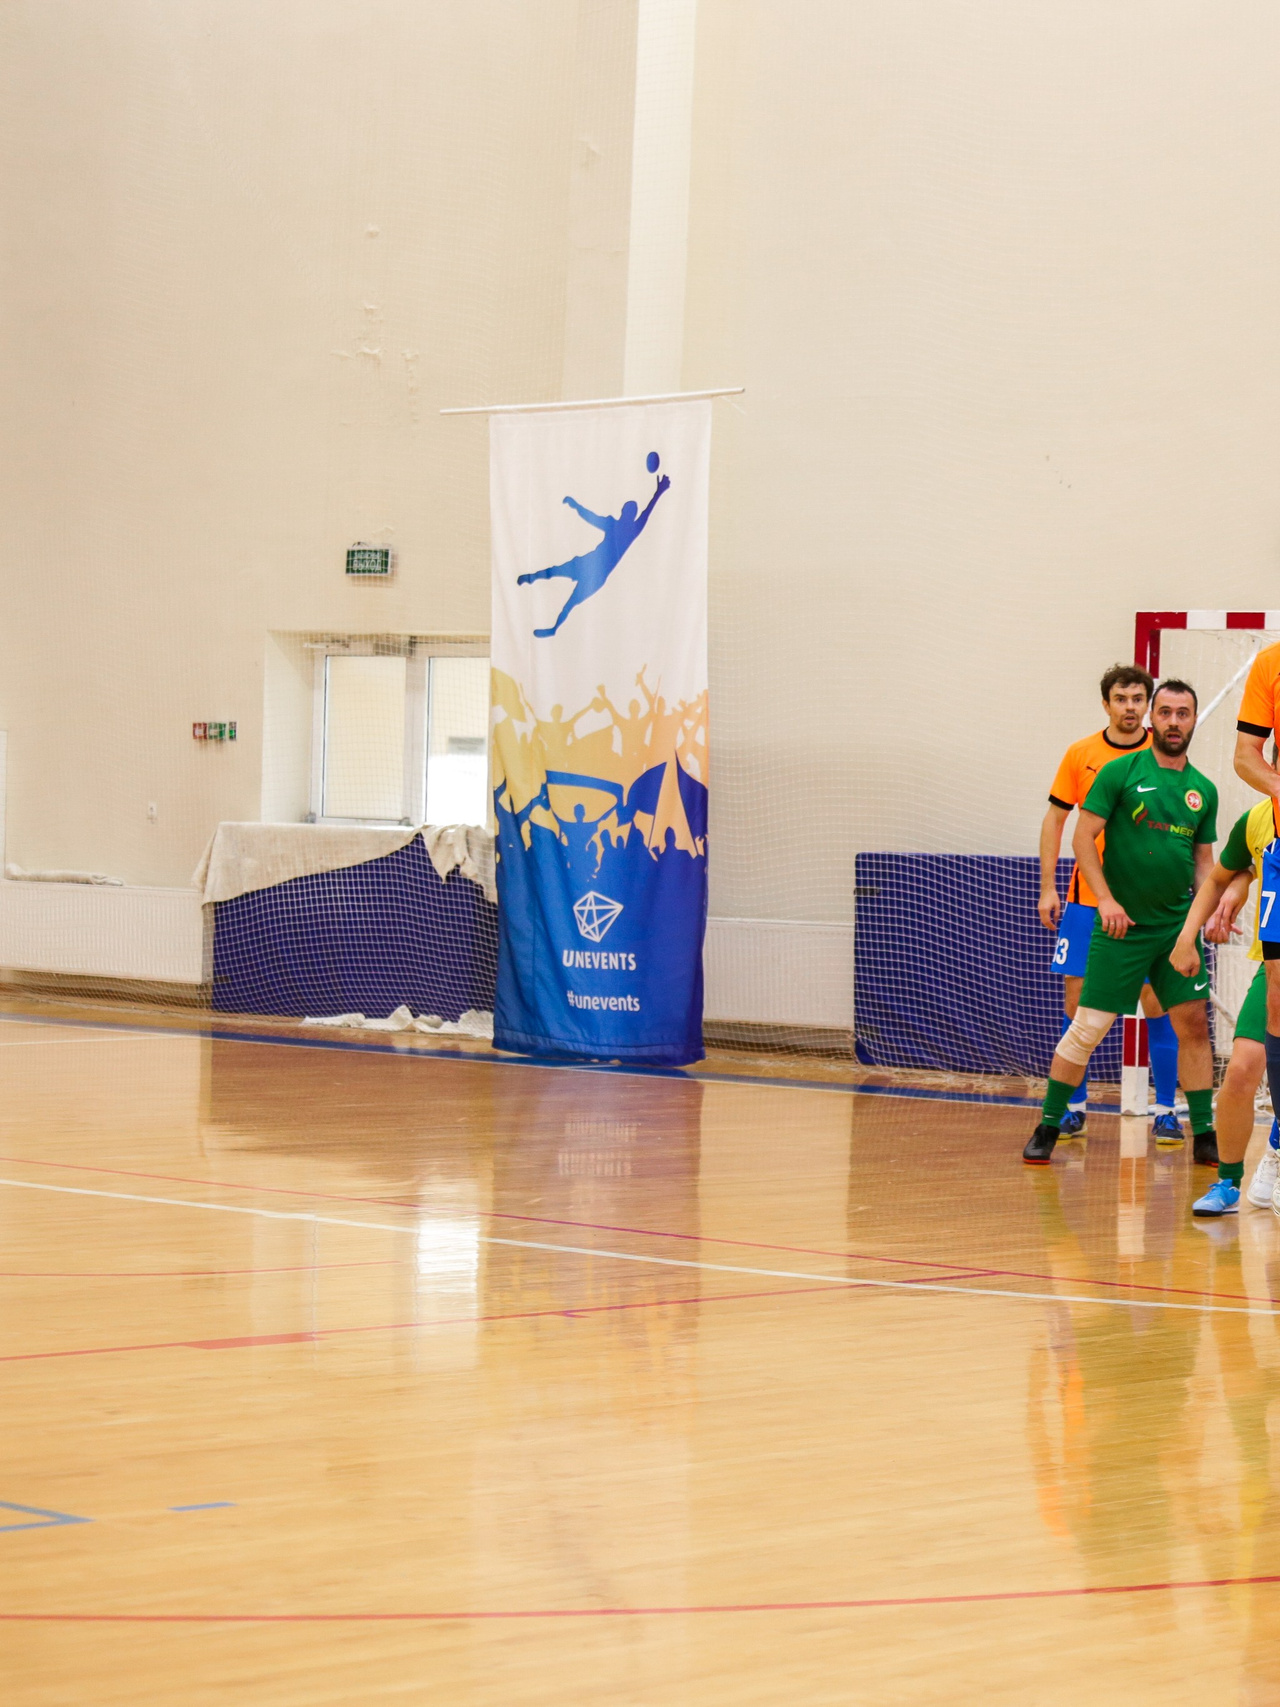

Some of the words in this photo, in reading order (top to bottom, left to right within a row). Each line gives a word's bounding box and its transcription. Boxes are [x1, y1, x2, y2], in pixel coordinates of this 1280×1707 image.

[1260, 890, 1277, 929] 7
[562, 949, 637, 971] UNEVENTS
[566, 989, 641, 1012] #unevents
